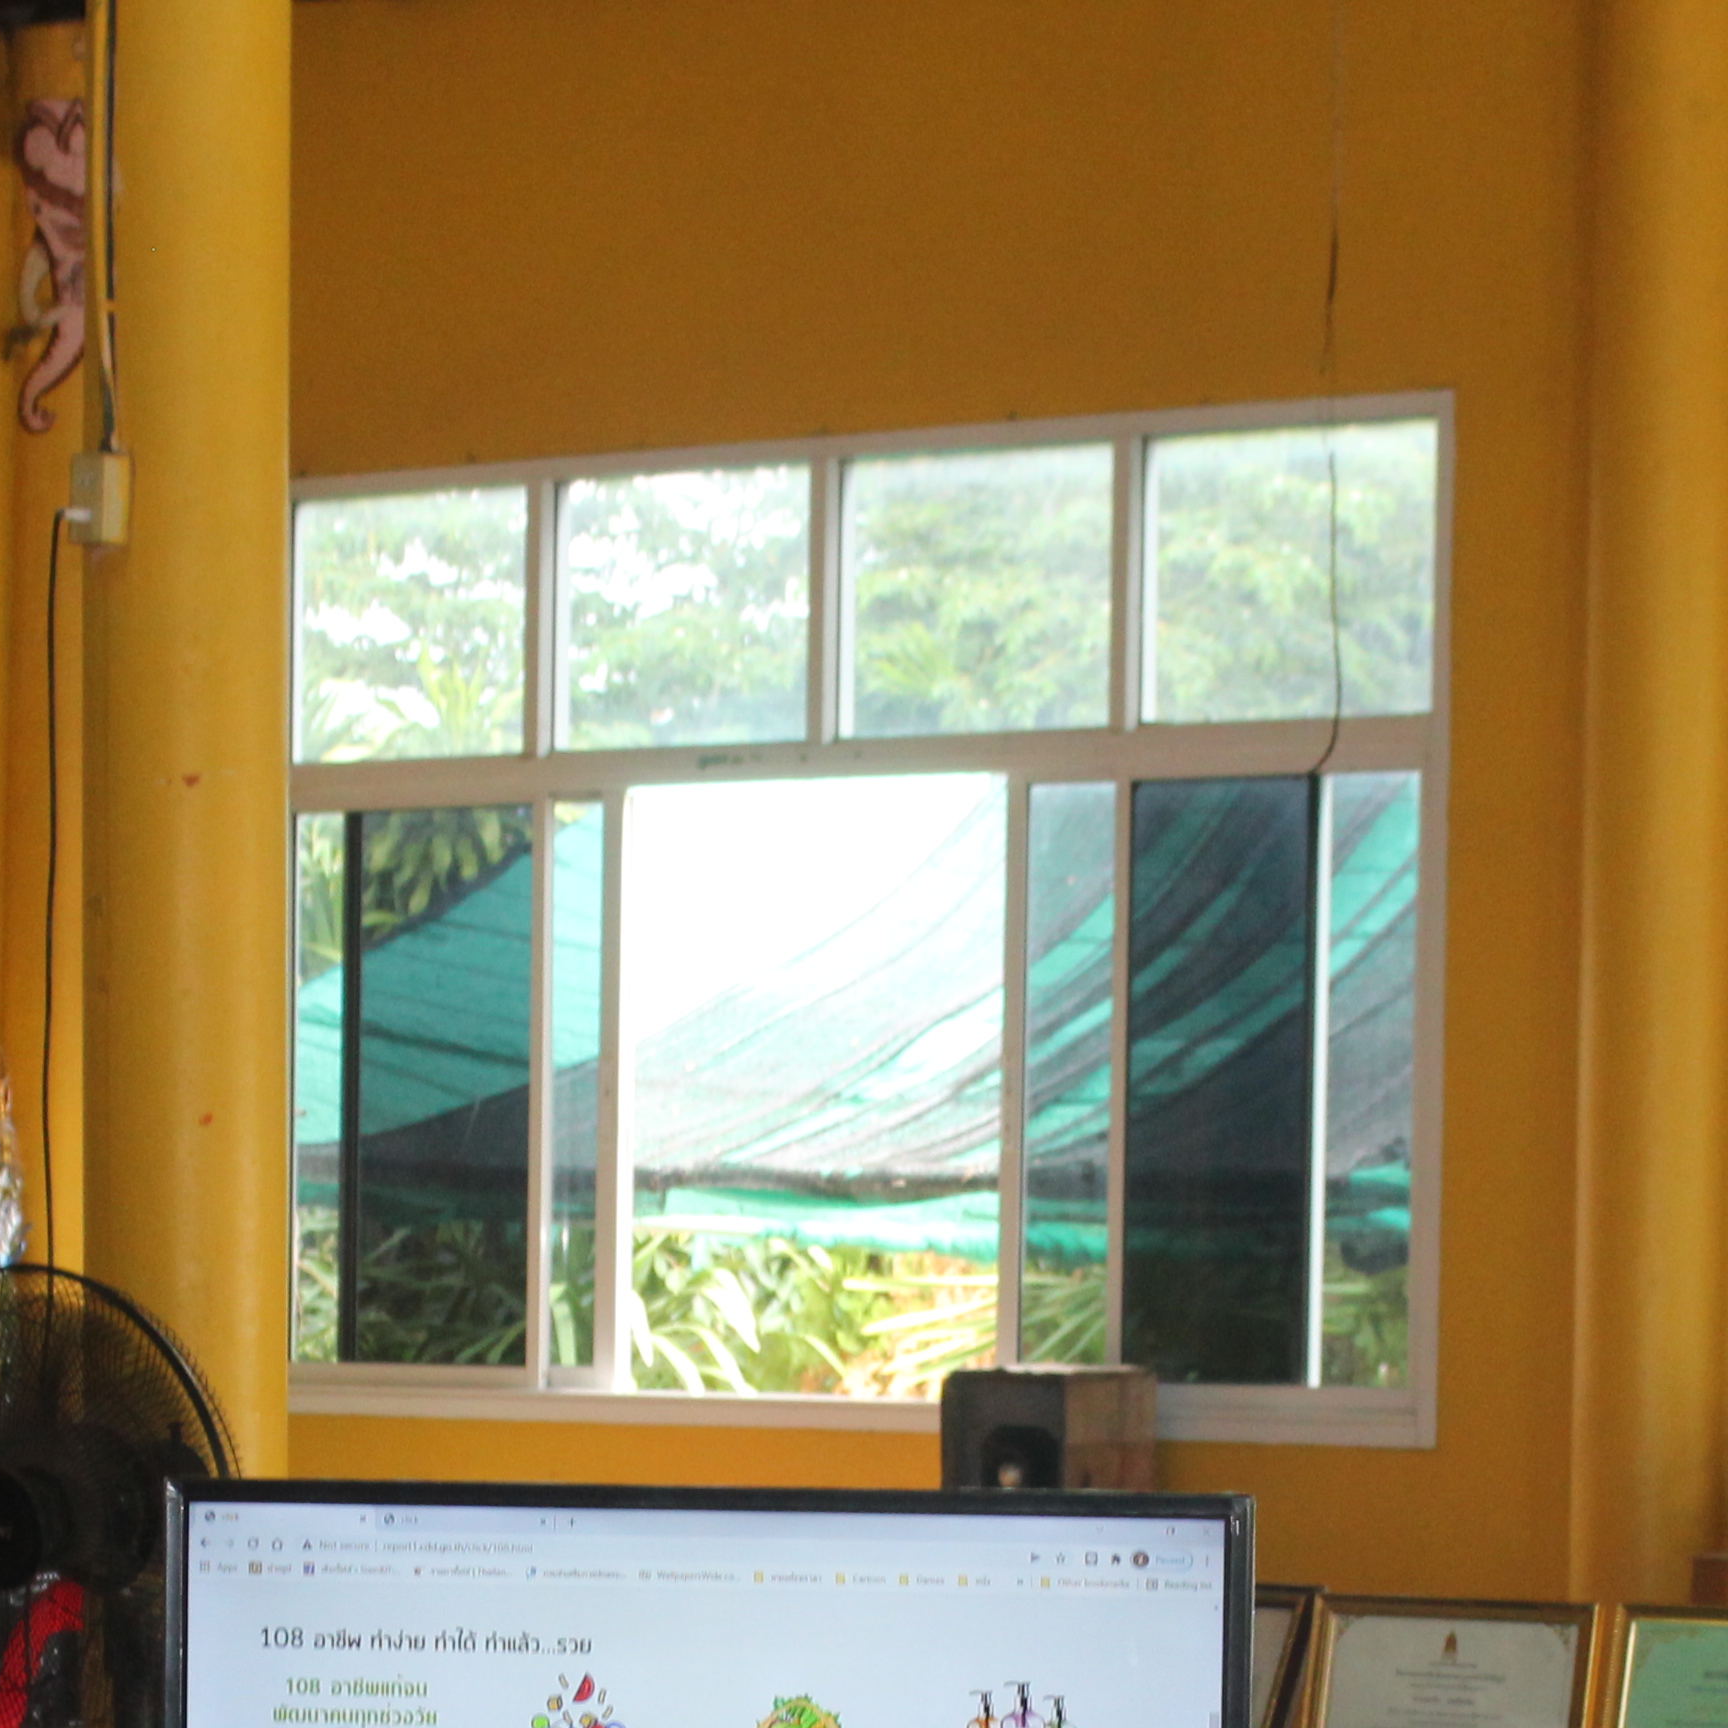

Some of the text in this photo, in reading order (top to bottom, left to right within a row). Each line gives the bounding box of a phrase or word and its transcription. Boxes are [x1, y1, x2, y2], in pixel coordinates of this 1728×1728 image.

[260, 1627, 304, 1649] 108
[313, 1628, 362, 1651] อาชีพ
[371, 1628, 426, 1651] ทำง่าย
[434, 1627, 477, 1652] ทำได้
[285, 1677, 321, 1696] 108
